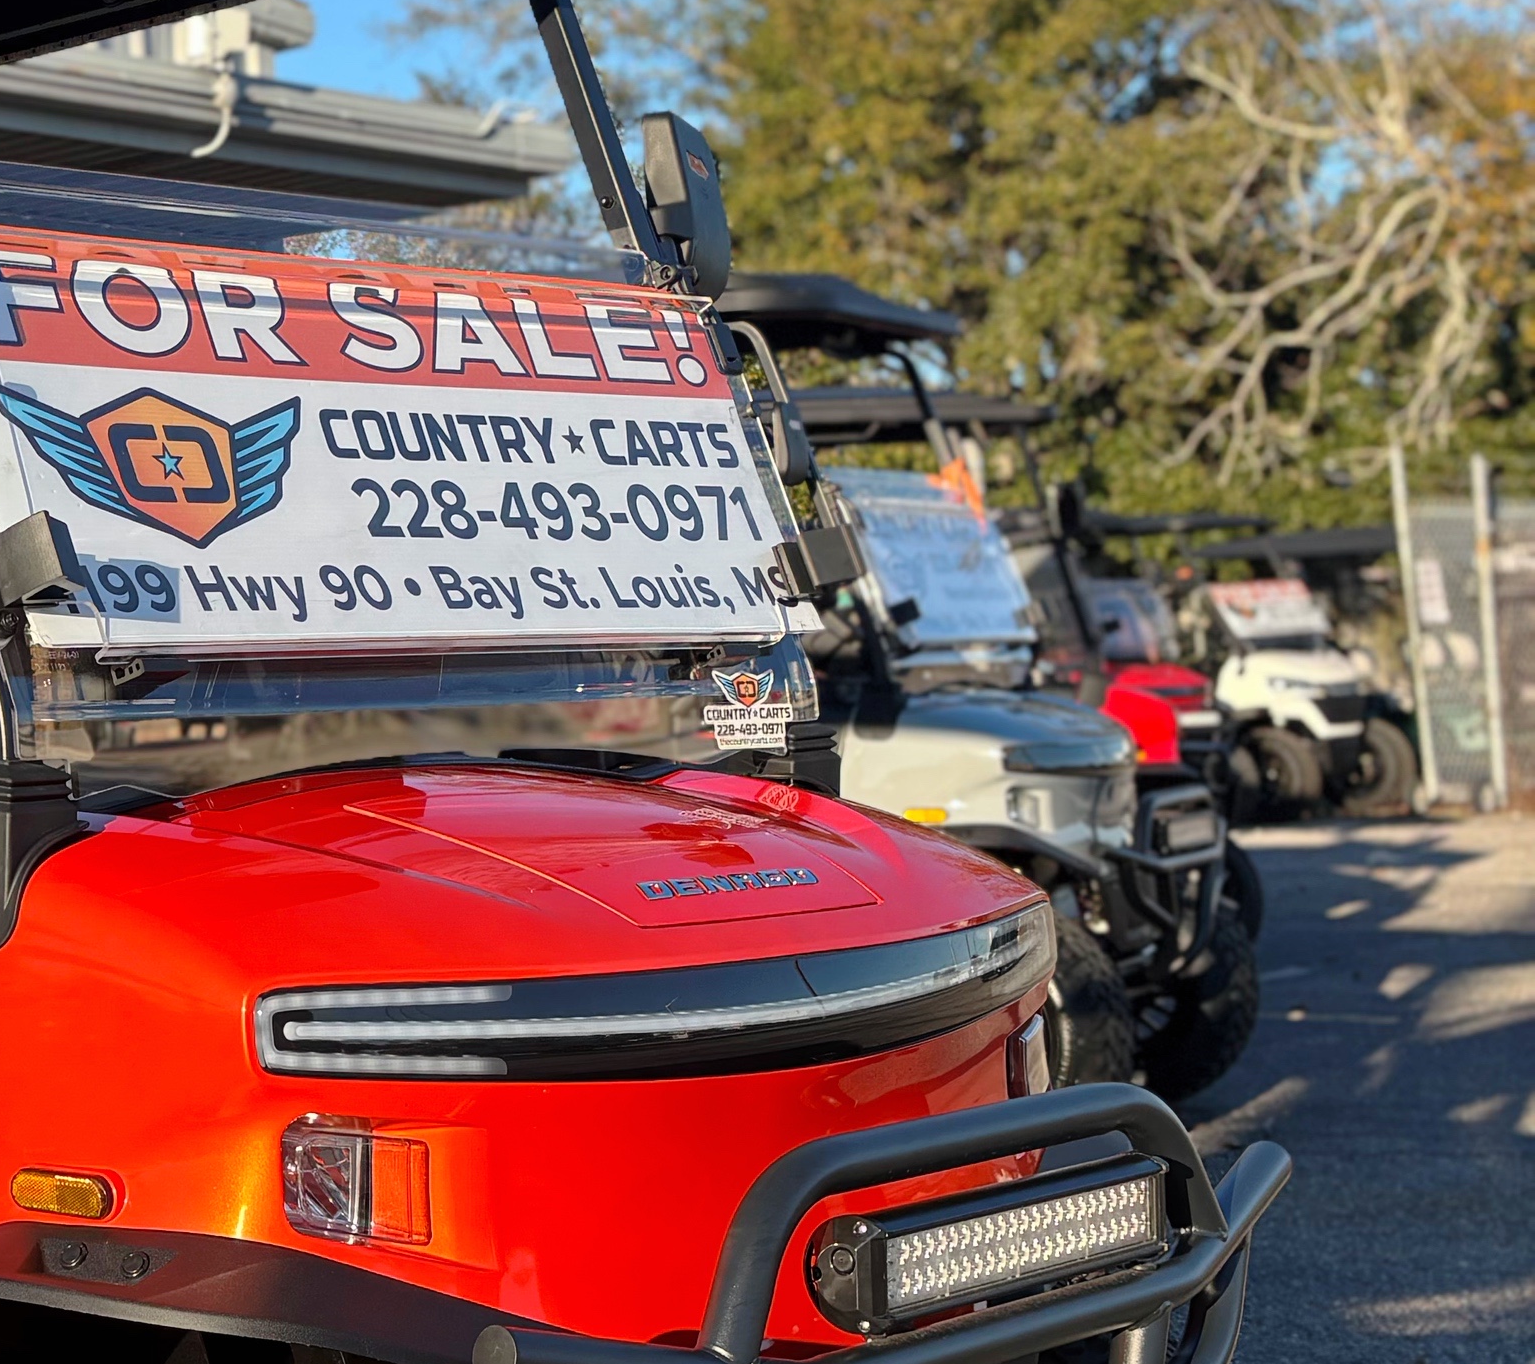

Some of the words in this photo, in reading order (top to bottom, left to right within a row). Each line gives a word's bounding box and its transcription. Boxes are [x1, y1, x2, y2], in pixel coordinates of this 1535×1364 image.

[327, 282, 707, 387] SALE!
[318, 408, 556, 464] COUNTRY
[589, 418, 740, 469] CARTS
[350, 477, 764, 542] 228-493-0971
[67, 564, 176, 614] 199
[183, 565, 308, 623] Hwy
[319, 564, 393, 611] 90
[428, 565, 525, 620] Bay
[529, 565, 601, 610] St.
[598, 563, 736, 615] Louis,
[706, 708, 752, 720] COUNTRY
[759, 706, 791, 718] CARTS
[717, 722, 783, 736] 228-493-0971
[719, 736, 783, 746] thecountrycarts.com
[635, 867, 820, 901] DENAGO
